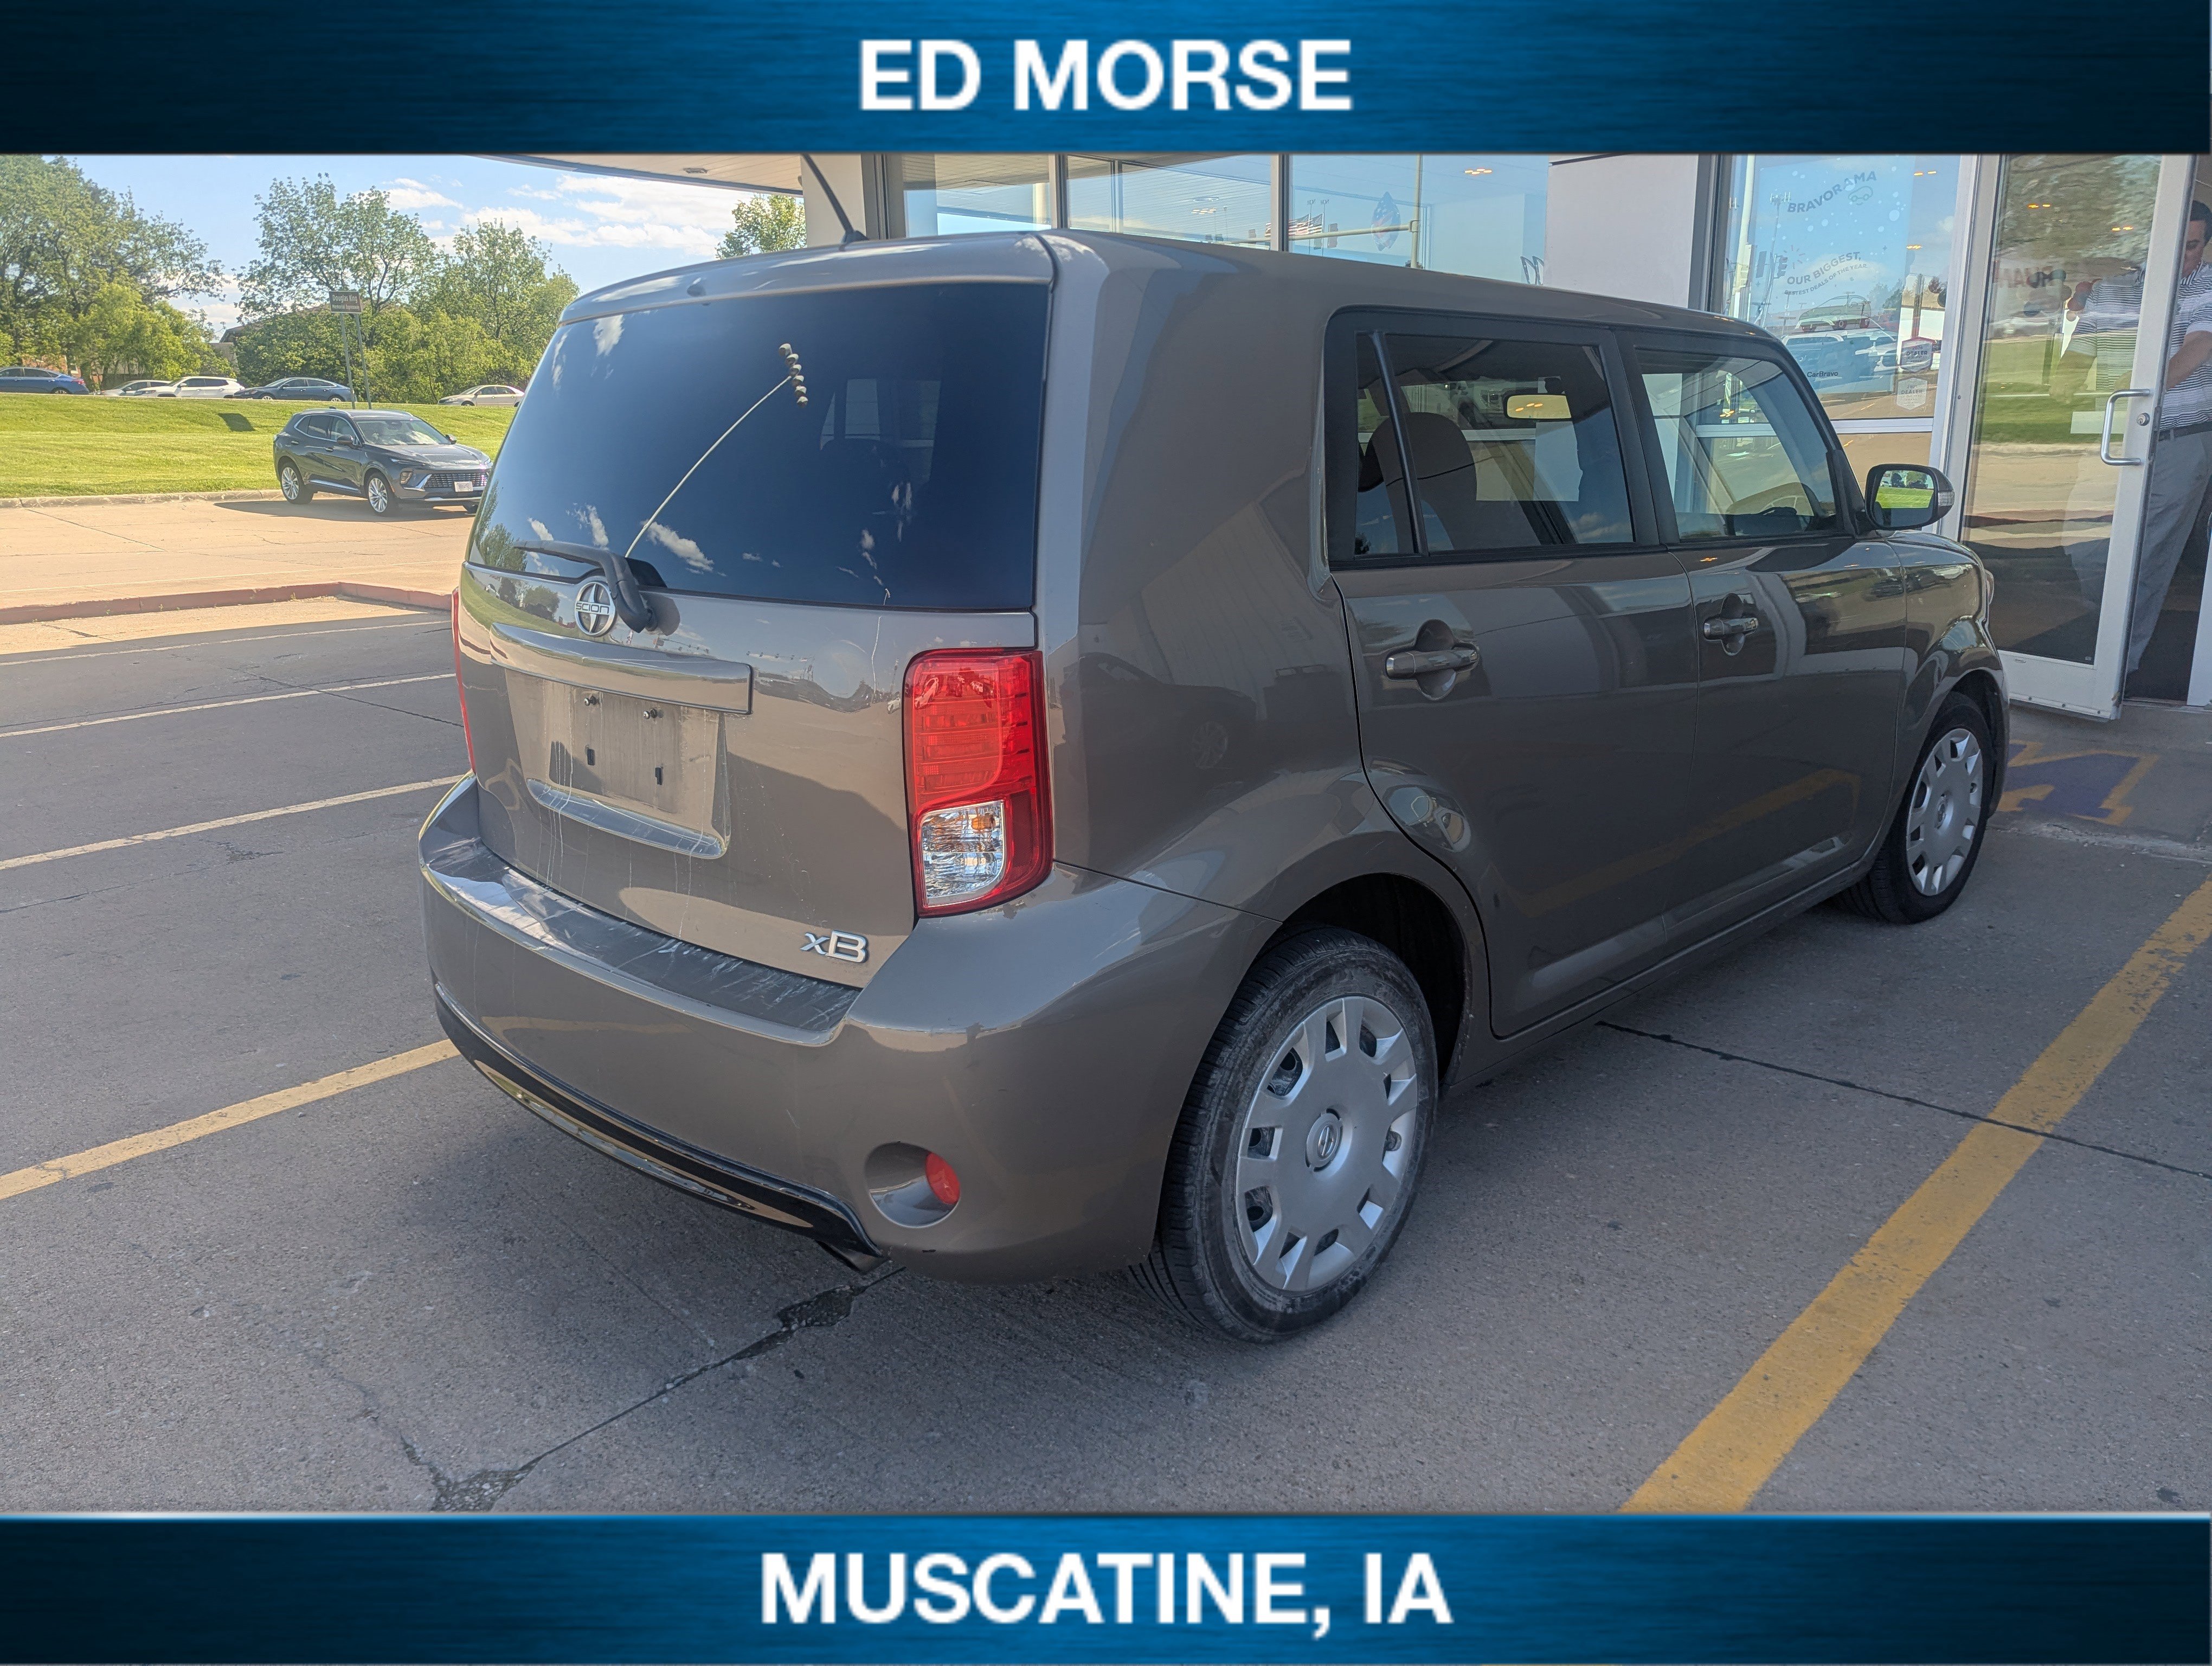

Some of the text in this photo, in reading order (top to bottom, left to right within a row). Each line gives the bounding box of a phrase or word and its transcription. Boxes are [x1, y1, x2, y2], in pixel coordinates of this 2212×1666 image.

[1787, 171, 1876, 213] BRAVORAMA
[1787, 251, 1861, 285] OUR BIGGEST,
[1810, 279, 1829, 291] DEALS
[1829, 272, 1837, 280] OF
[1837, 267, 1849, 275] THE
[332, 294, 358, 303] Douglas King
[575, 603, 610, 614] SCION
[800, 930, 868, 963] xB
